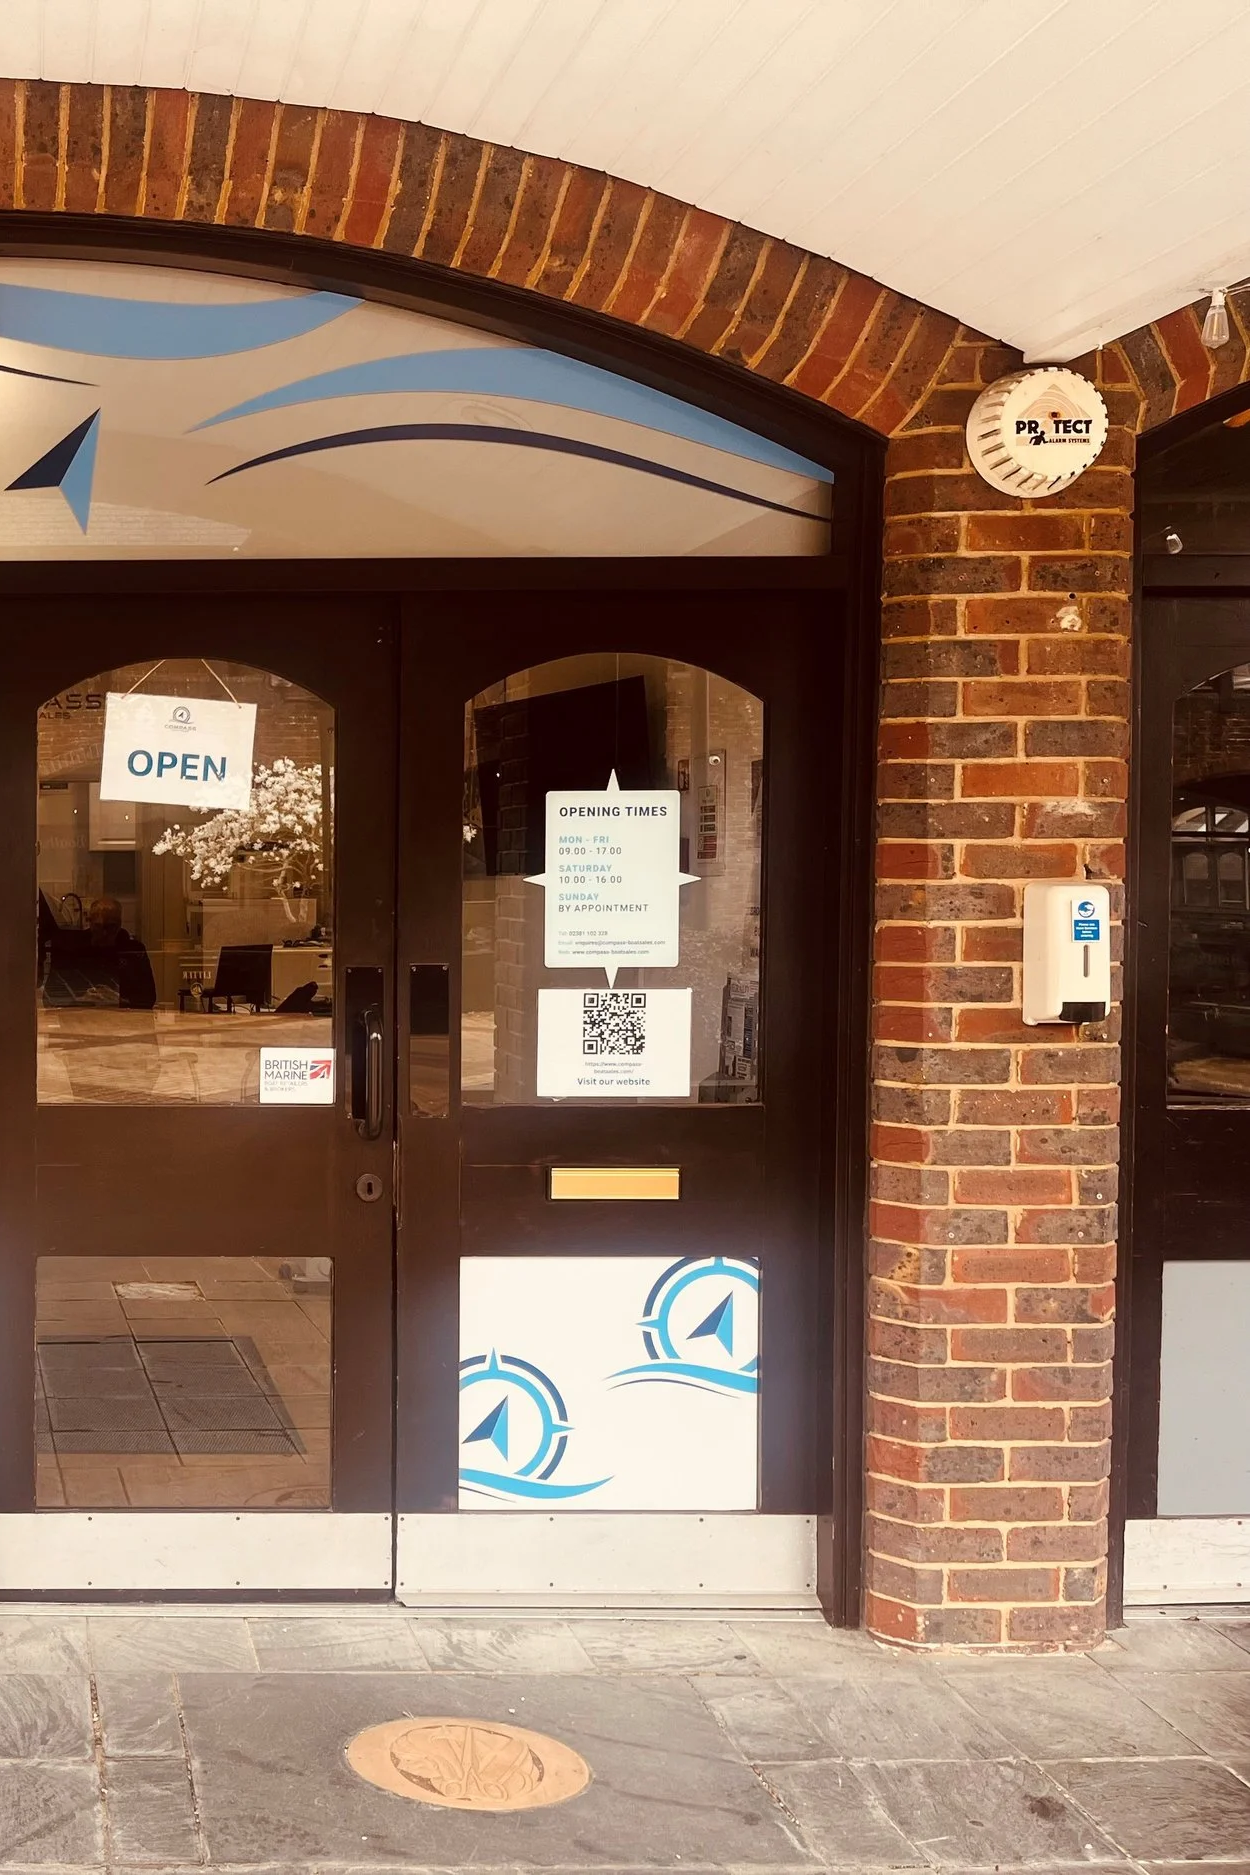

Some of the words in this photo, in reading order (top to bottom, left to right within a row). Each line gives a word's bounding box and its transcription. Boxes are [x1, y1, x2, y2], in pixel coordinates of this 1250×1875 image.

[164, 724, 197, 732] COMPASS
[127, 750, 227, 782] OPEN
[559, 806, 621, 817] OPENING
[625, 806, 668, 817] TIMES
[559, 836, 583, 844] MON
[593, 835, 609, 844] FRI
[559, 847, 586, 856] 09.00
[559, 864, 612, 873] SATURDAY
[559, 893, 599, 901] SUNDAY
[558, 904, 571, 912] BY
[574, 904, 649, 912] APPOINTMENT
[264, 1060, 308, 1070] BRITISH
[264, 1071, 308, 1080] MARINE
